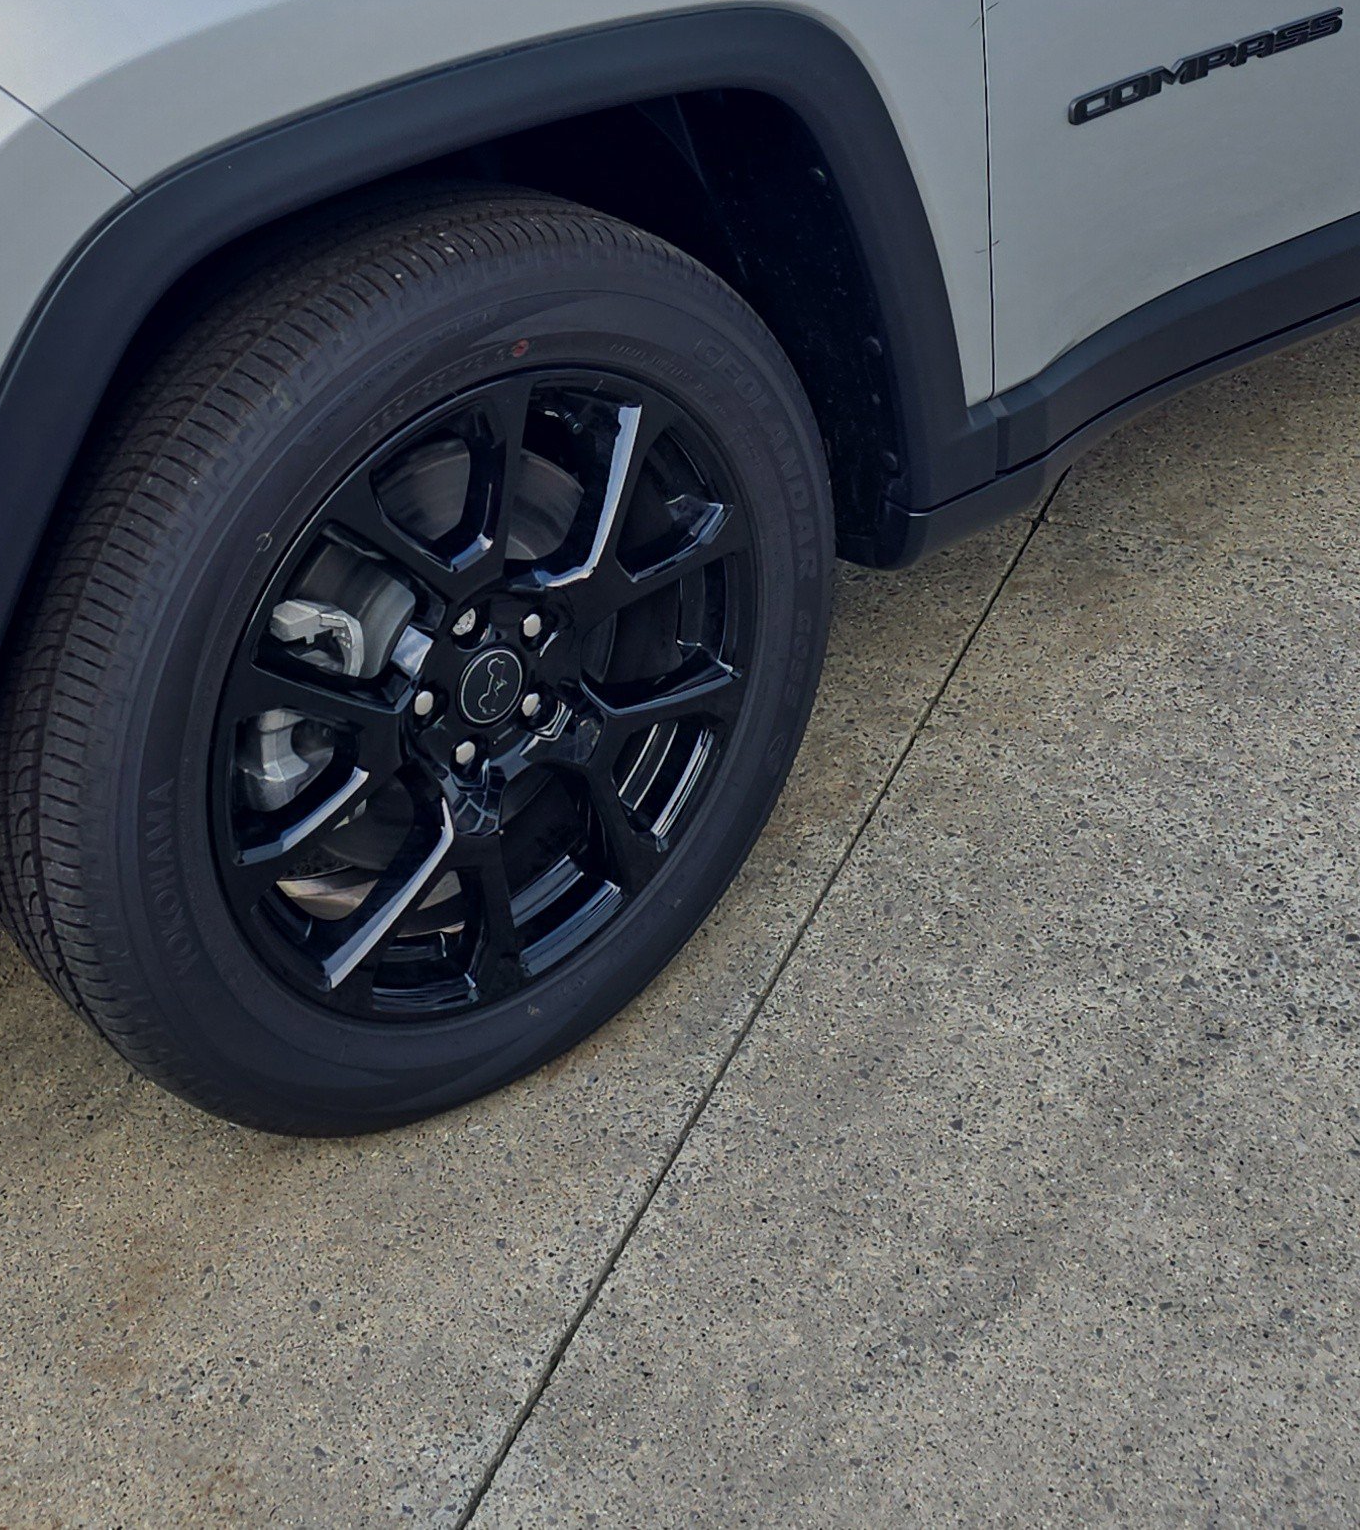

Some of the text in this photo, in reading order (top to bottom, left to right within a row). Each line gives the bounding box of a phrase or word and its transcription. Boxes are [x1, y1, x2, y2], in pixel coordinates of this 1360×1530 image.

[1068, 6, 1343, 126] COMPASS
[694, 337, 818, 581] GEOLANDAR
[146, 777, 200, 977] YOKOHAMA
